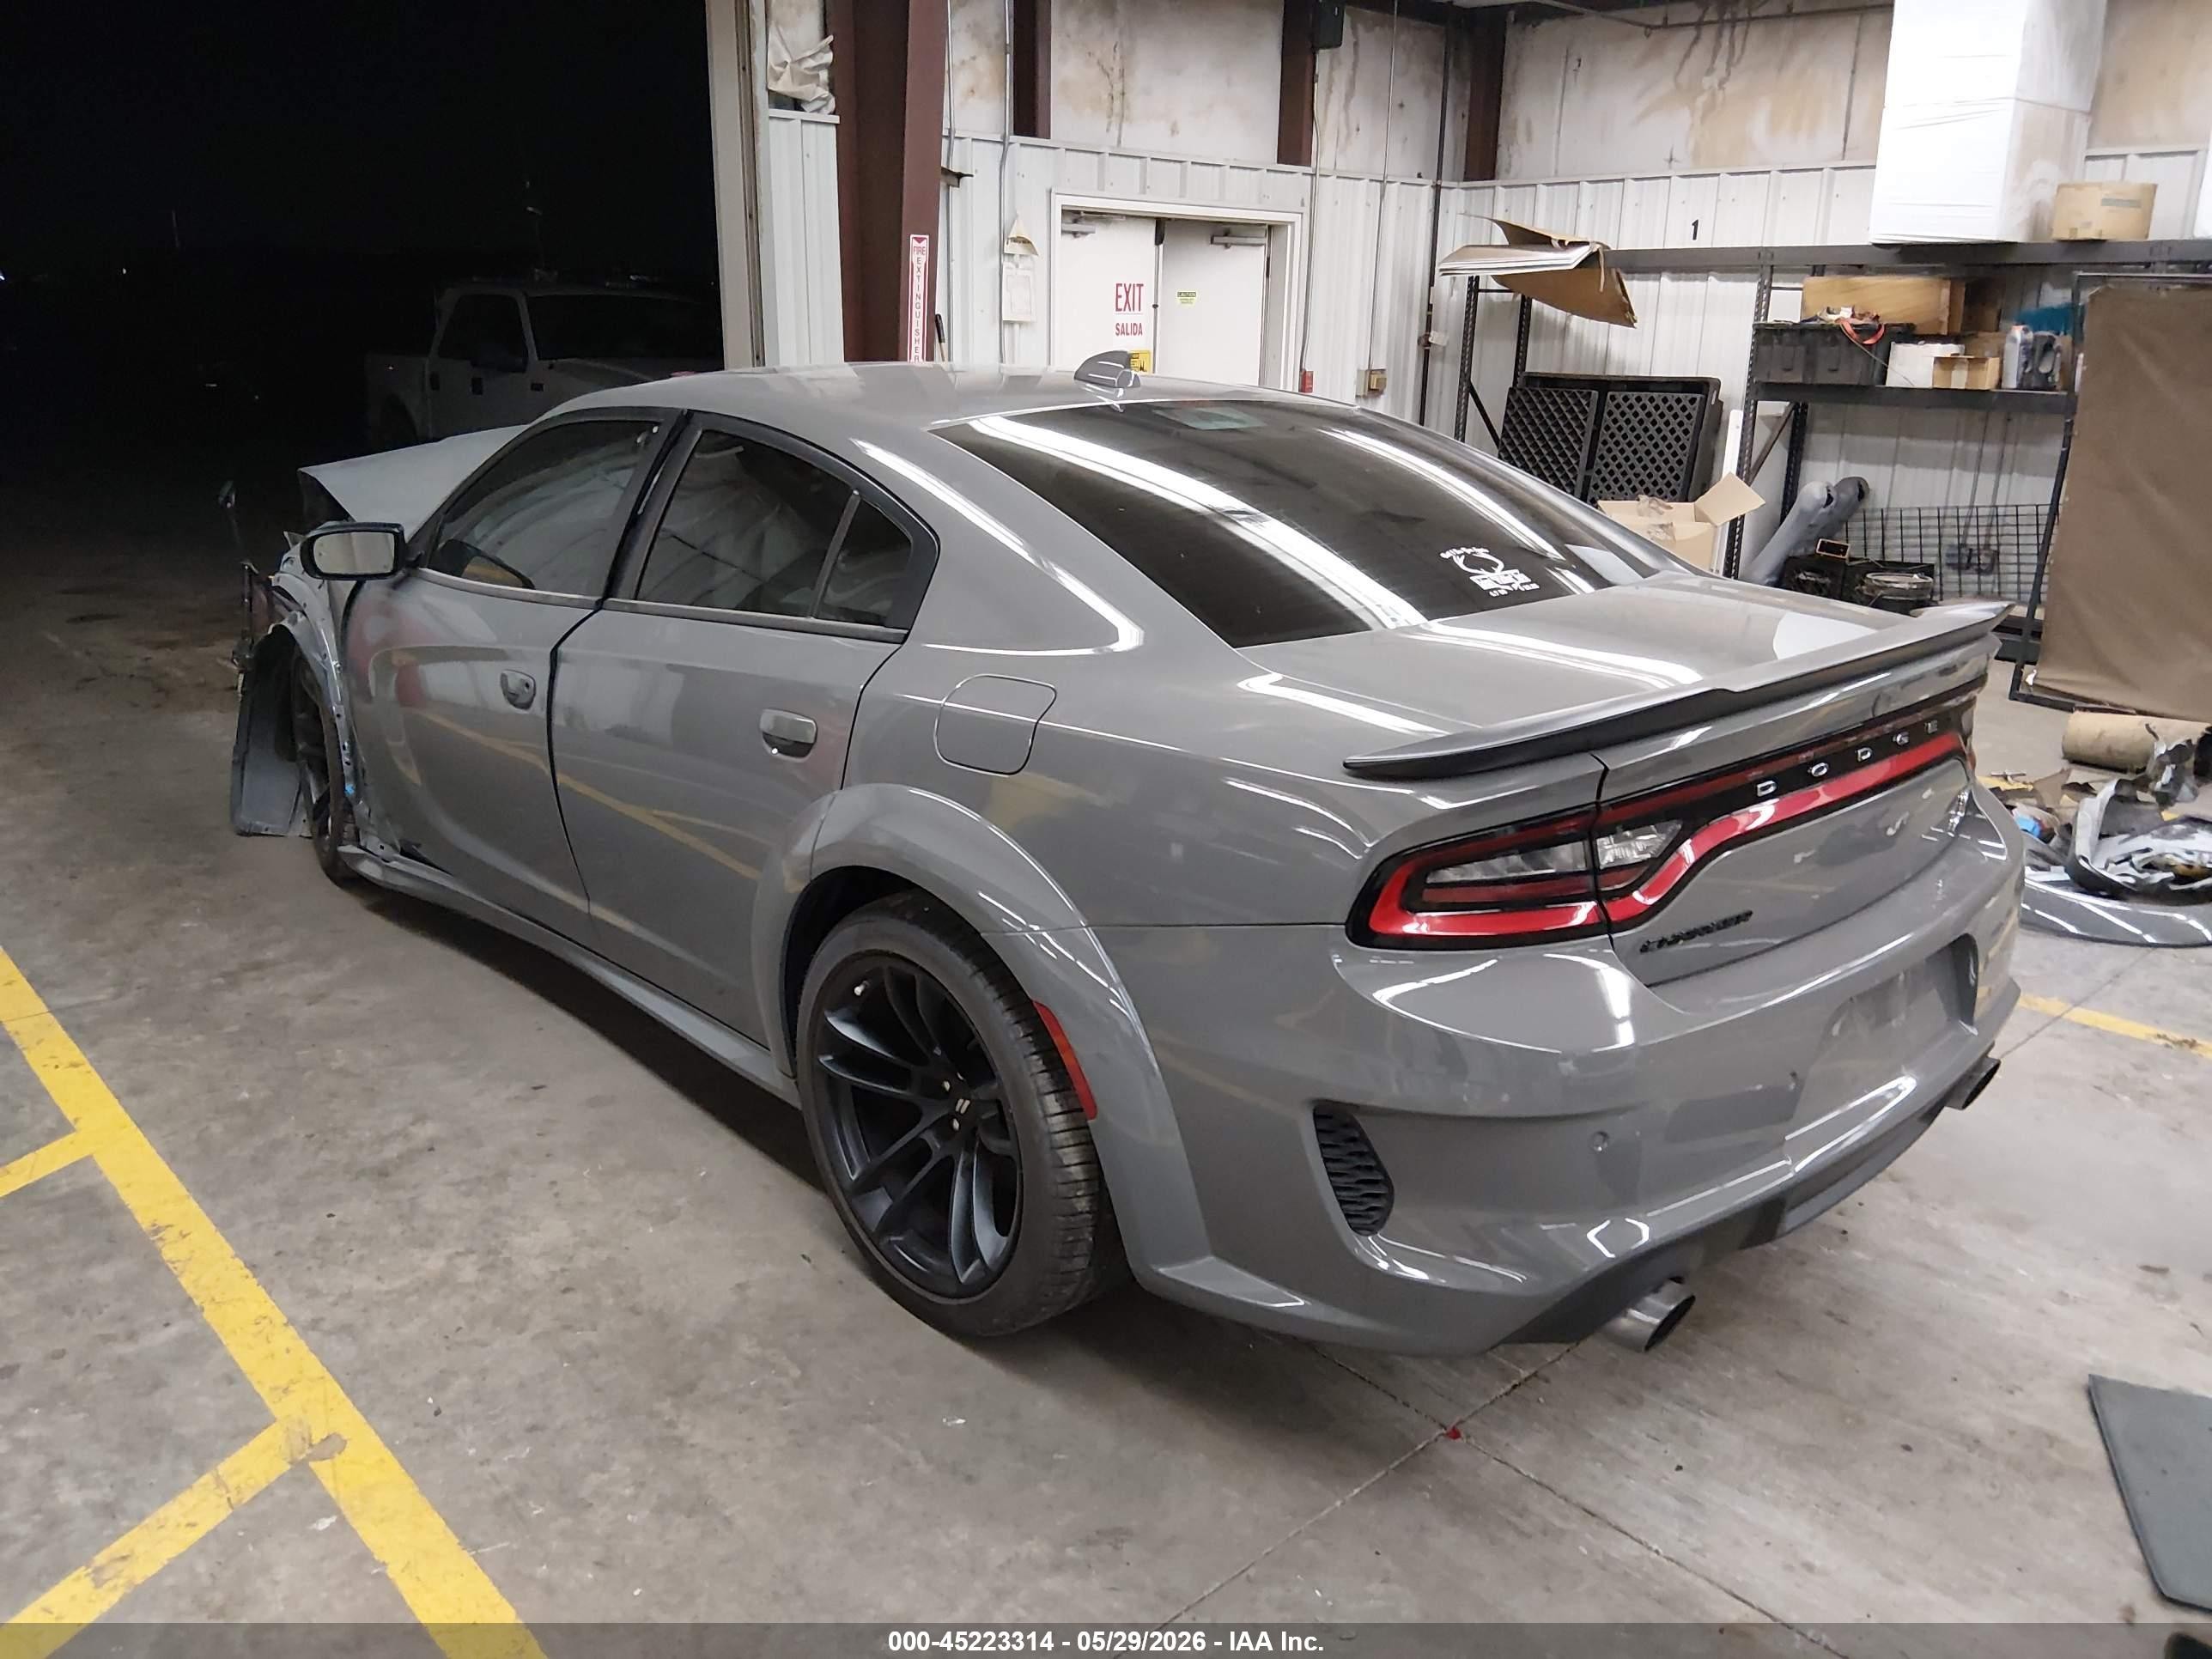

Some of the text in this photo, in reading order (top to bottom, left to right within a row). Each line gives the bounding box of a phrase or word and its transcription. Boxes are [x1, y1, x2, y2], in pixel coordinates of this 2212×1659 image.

[1692, 219, 1698, 240] 1
[913, 246, 926, 255] FIRE
[914, 257, 922, 362] EXTINGUISHER
[1115, 283, 1144, 312] EXIT
[1115, 323, 1143, 336] SALIDA
[1757, 720, 1938, 797] DODGE
